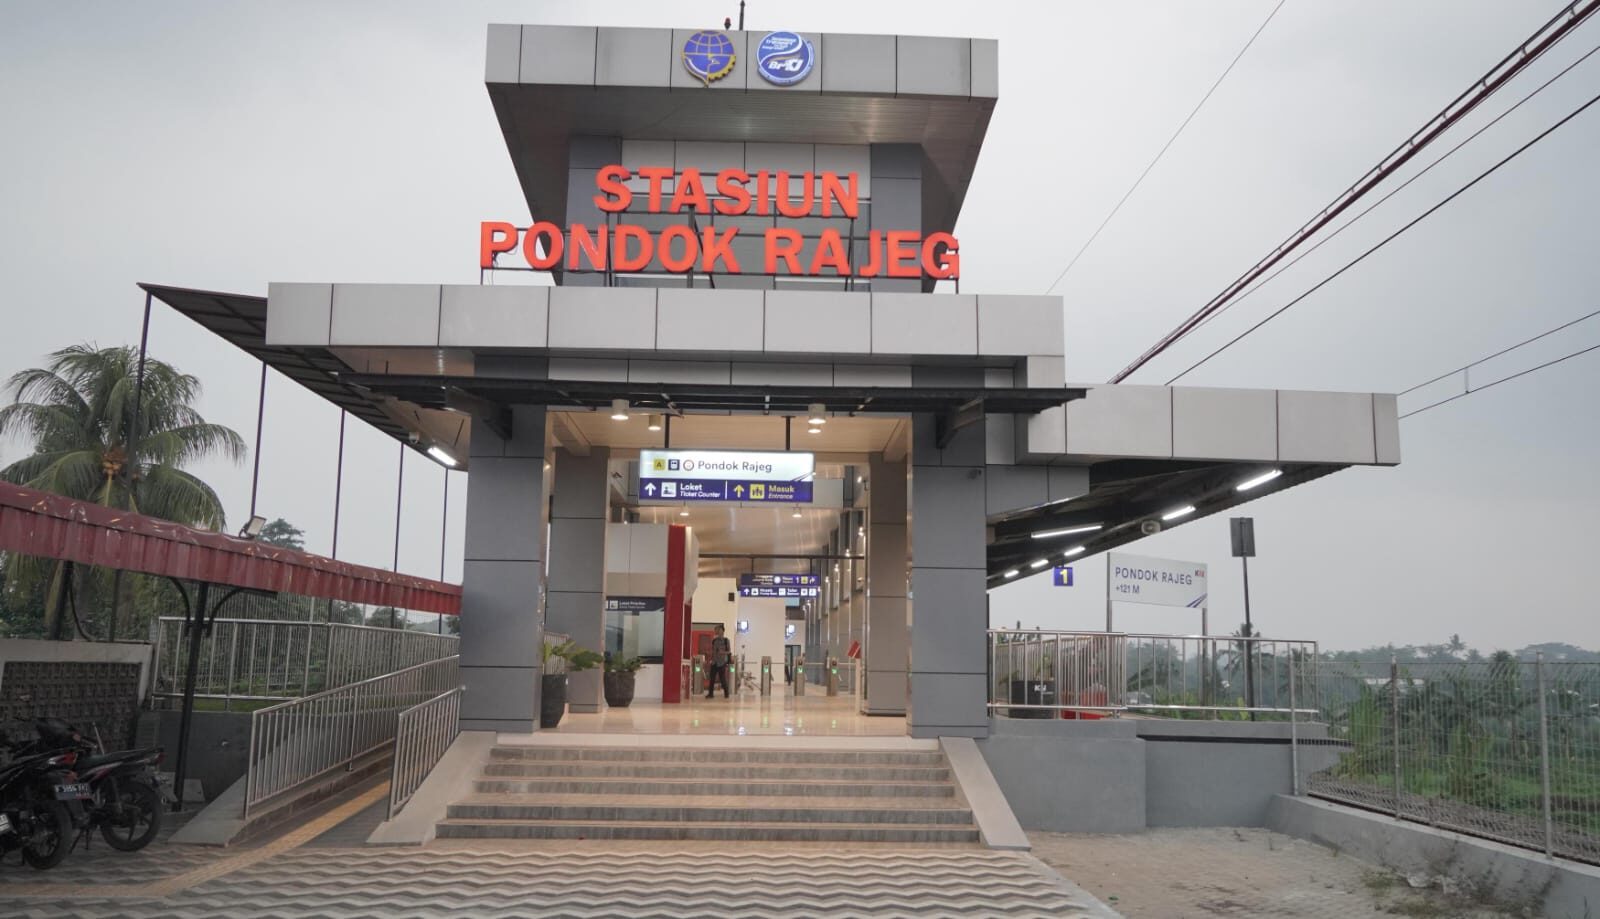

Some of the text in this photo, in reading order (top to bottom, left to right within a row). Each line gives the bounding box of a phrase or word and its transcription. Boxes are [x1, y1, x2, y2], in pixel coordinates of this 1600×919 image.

[593, 165, 858, 219] STASIUN
[481, 221, 960, 279] PONDOK RAJEG
[698, 460, 738, 471] Pondok
[742, 461, 772, 473] Rajeg
[680, 483, 703, 491] Loket
[768, 485, 795, 493] Masuk
[1060, 569, 1069, 585] 1
[1115, 566, 1193, 586] PONDOK RAJEG
[1115, 584, 1140, 595] +121 M
